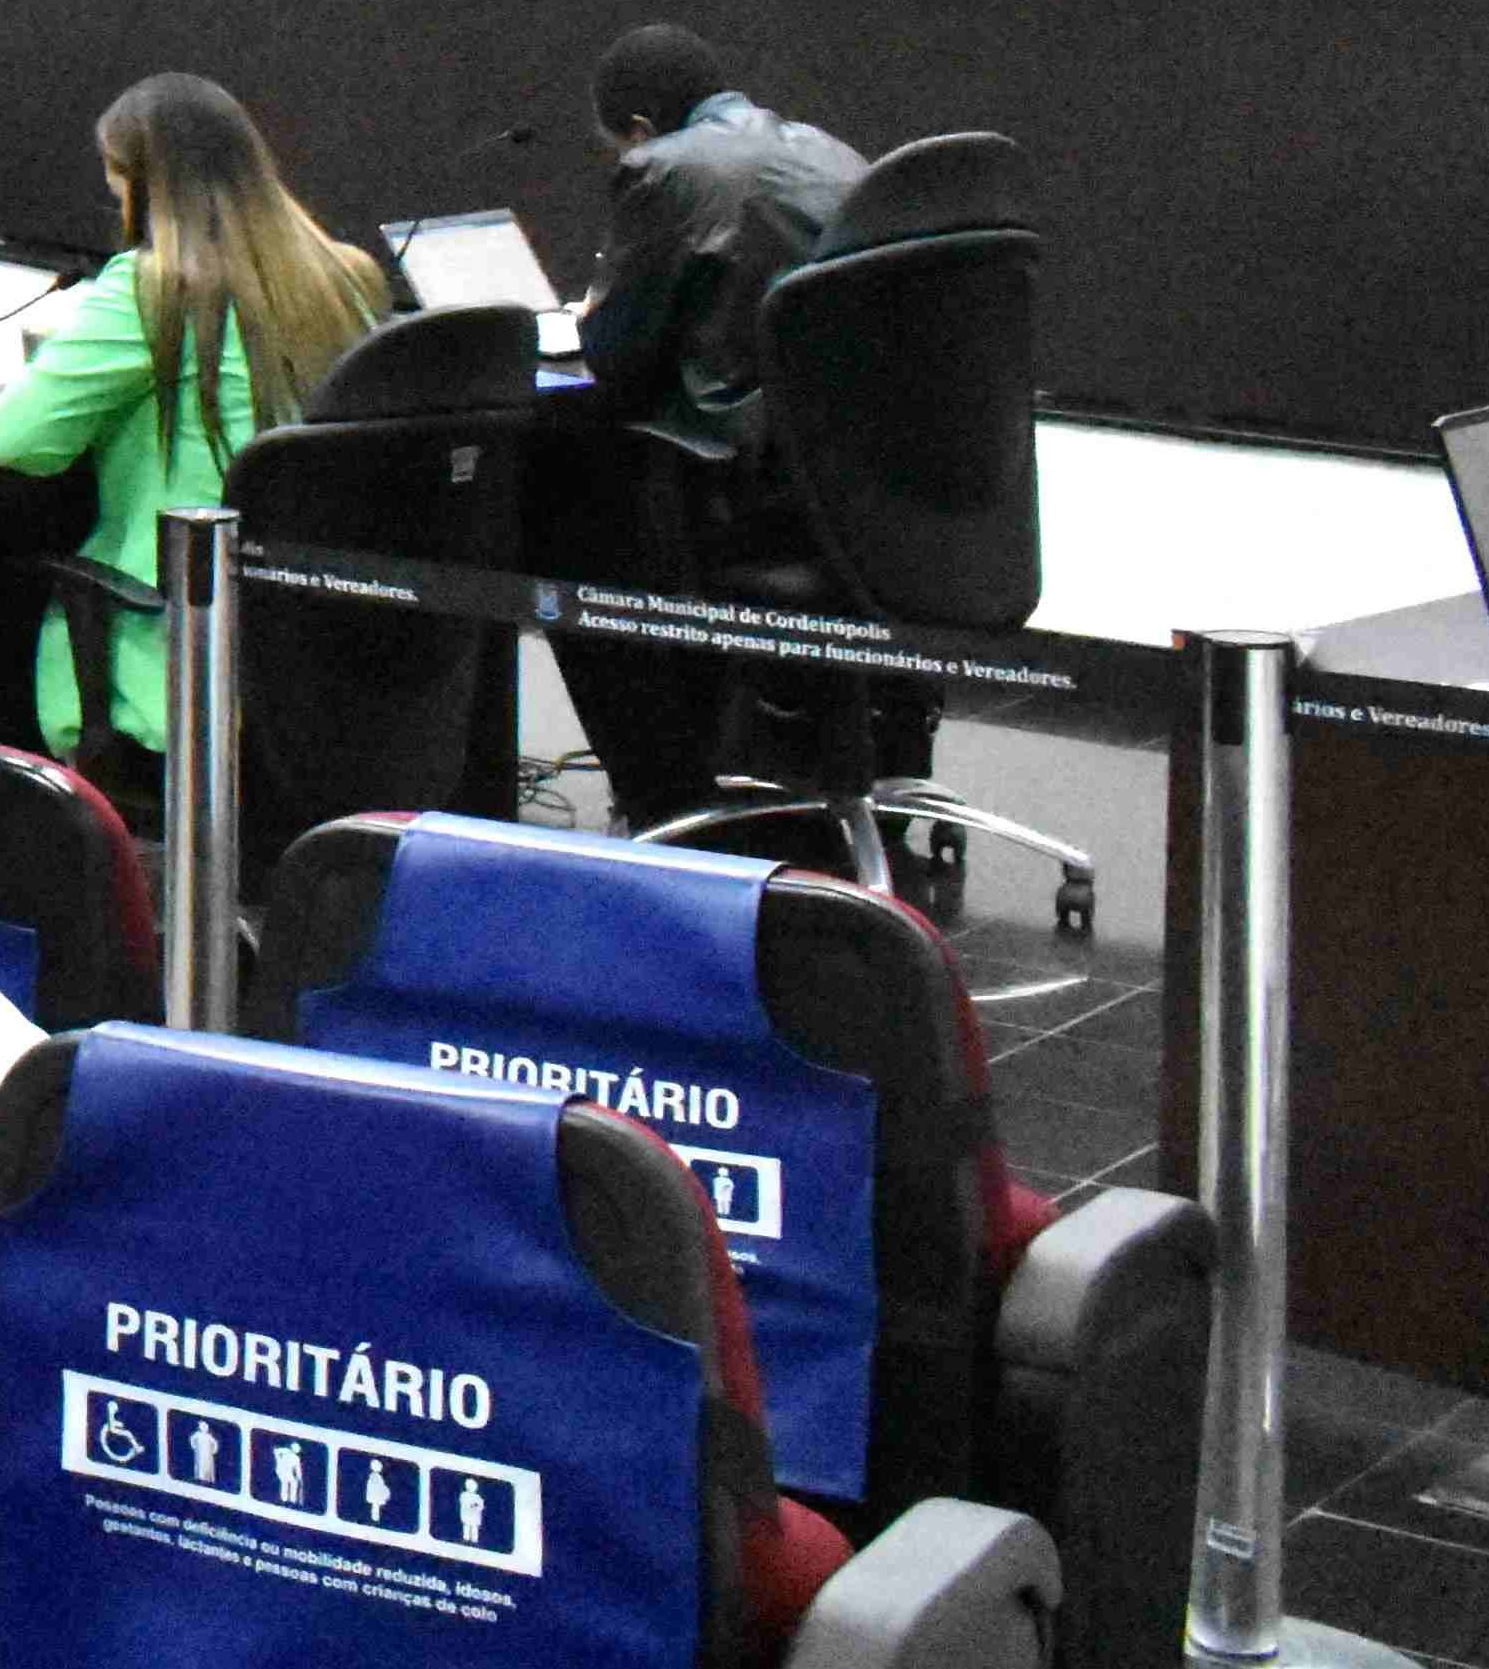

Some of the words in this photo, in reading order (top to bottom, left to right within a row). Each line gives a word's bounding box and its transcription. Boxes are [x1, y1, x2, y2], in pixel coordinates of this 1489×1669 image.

[576, 585, 644, 611] Câmara
[647, 594, 735, 623] Municipal
[739, 605, 761, 626] de
[765, 611, 892, 642] Cordeirópolis
[578, 610, 638, 633] Acesso
[641, 619, 708, 644] restrito
[711, 630, 776, 652] apenas
[779, 641, 821, 659] para
[825, 642, 942, 673] funcionários
[946, 661, 959, 676] e
[962, 659, 1078, 690] Vereadores.
[1350, 707, 1364, 722] e
[105, 1300, 492, 1431] PRIORITÁRIO
[84, 1492, 147, 1520] Pessoas
[148, 1510, 181, 1529] com
[182, 1518, 258, 1551] deficiência
[260, 1539, 281, 1557] ou
[282, 1544, 373, 1577] mobilidade
[454, 1580, 518, 1611] idosos,
[255, 1559, 319, 1586] pessoas
[321, 1573, 359, 1594] com
[361, 1582, 433, 1610] crianças
[434, 1596, 458, 1616] de
[459, 1605, 499, 1624] colo
